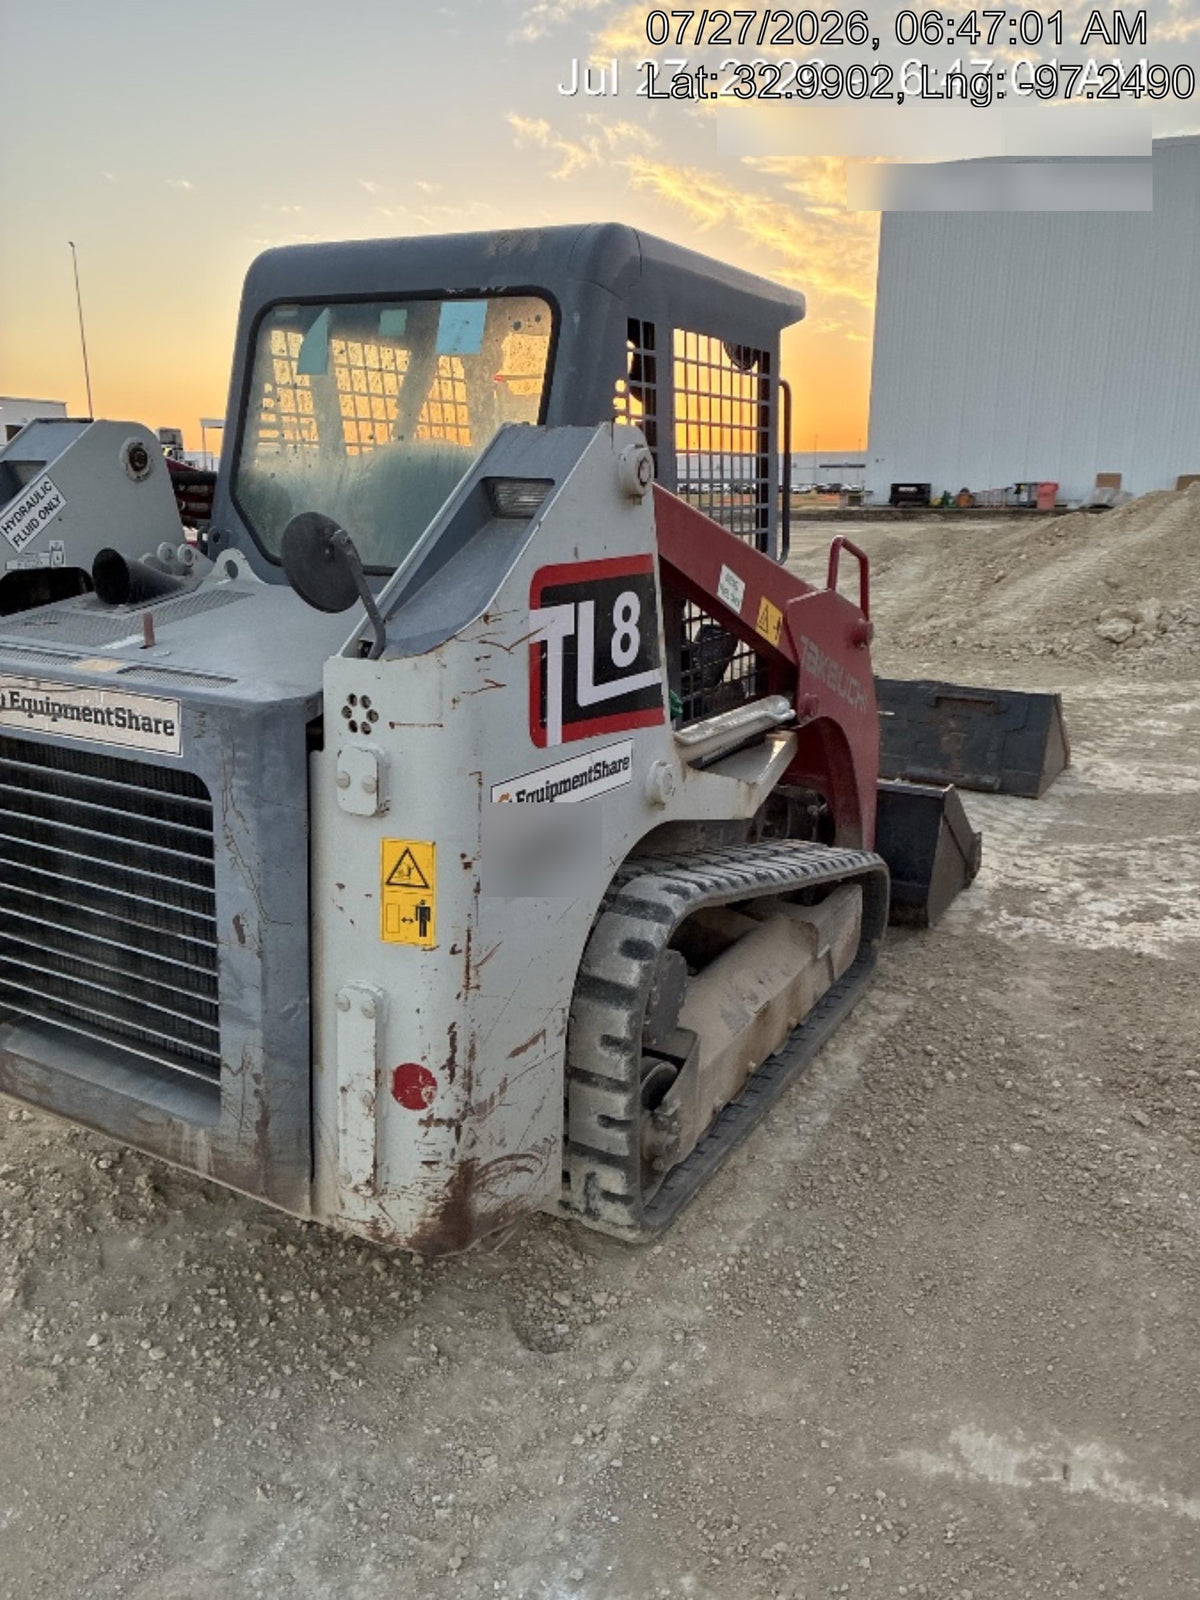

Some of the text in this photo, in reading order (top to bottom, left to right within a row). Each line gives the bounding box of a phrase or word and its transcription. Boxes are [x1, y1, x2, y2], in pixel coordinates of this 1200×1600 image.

[1, 480, 52, 535] HYDRAULIC
[12, 518, 40, 548] FLUID
[38, 494, 61, 521] ONLY
[8, 691, 175, 736] EquipmentShare
